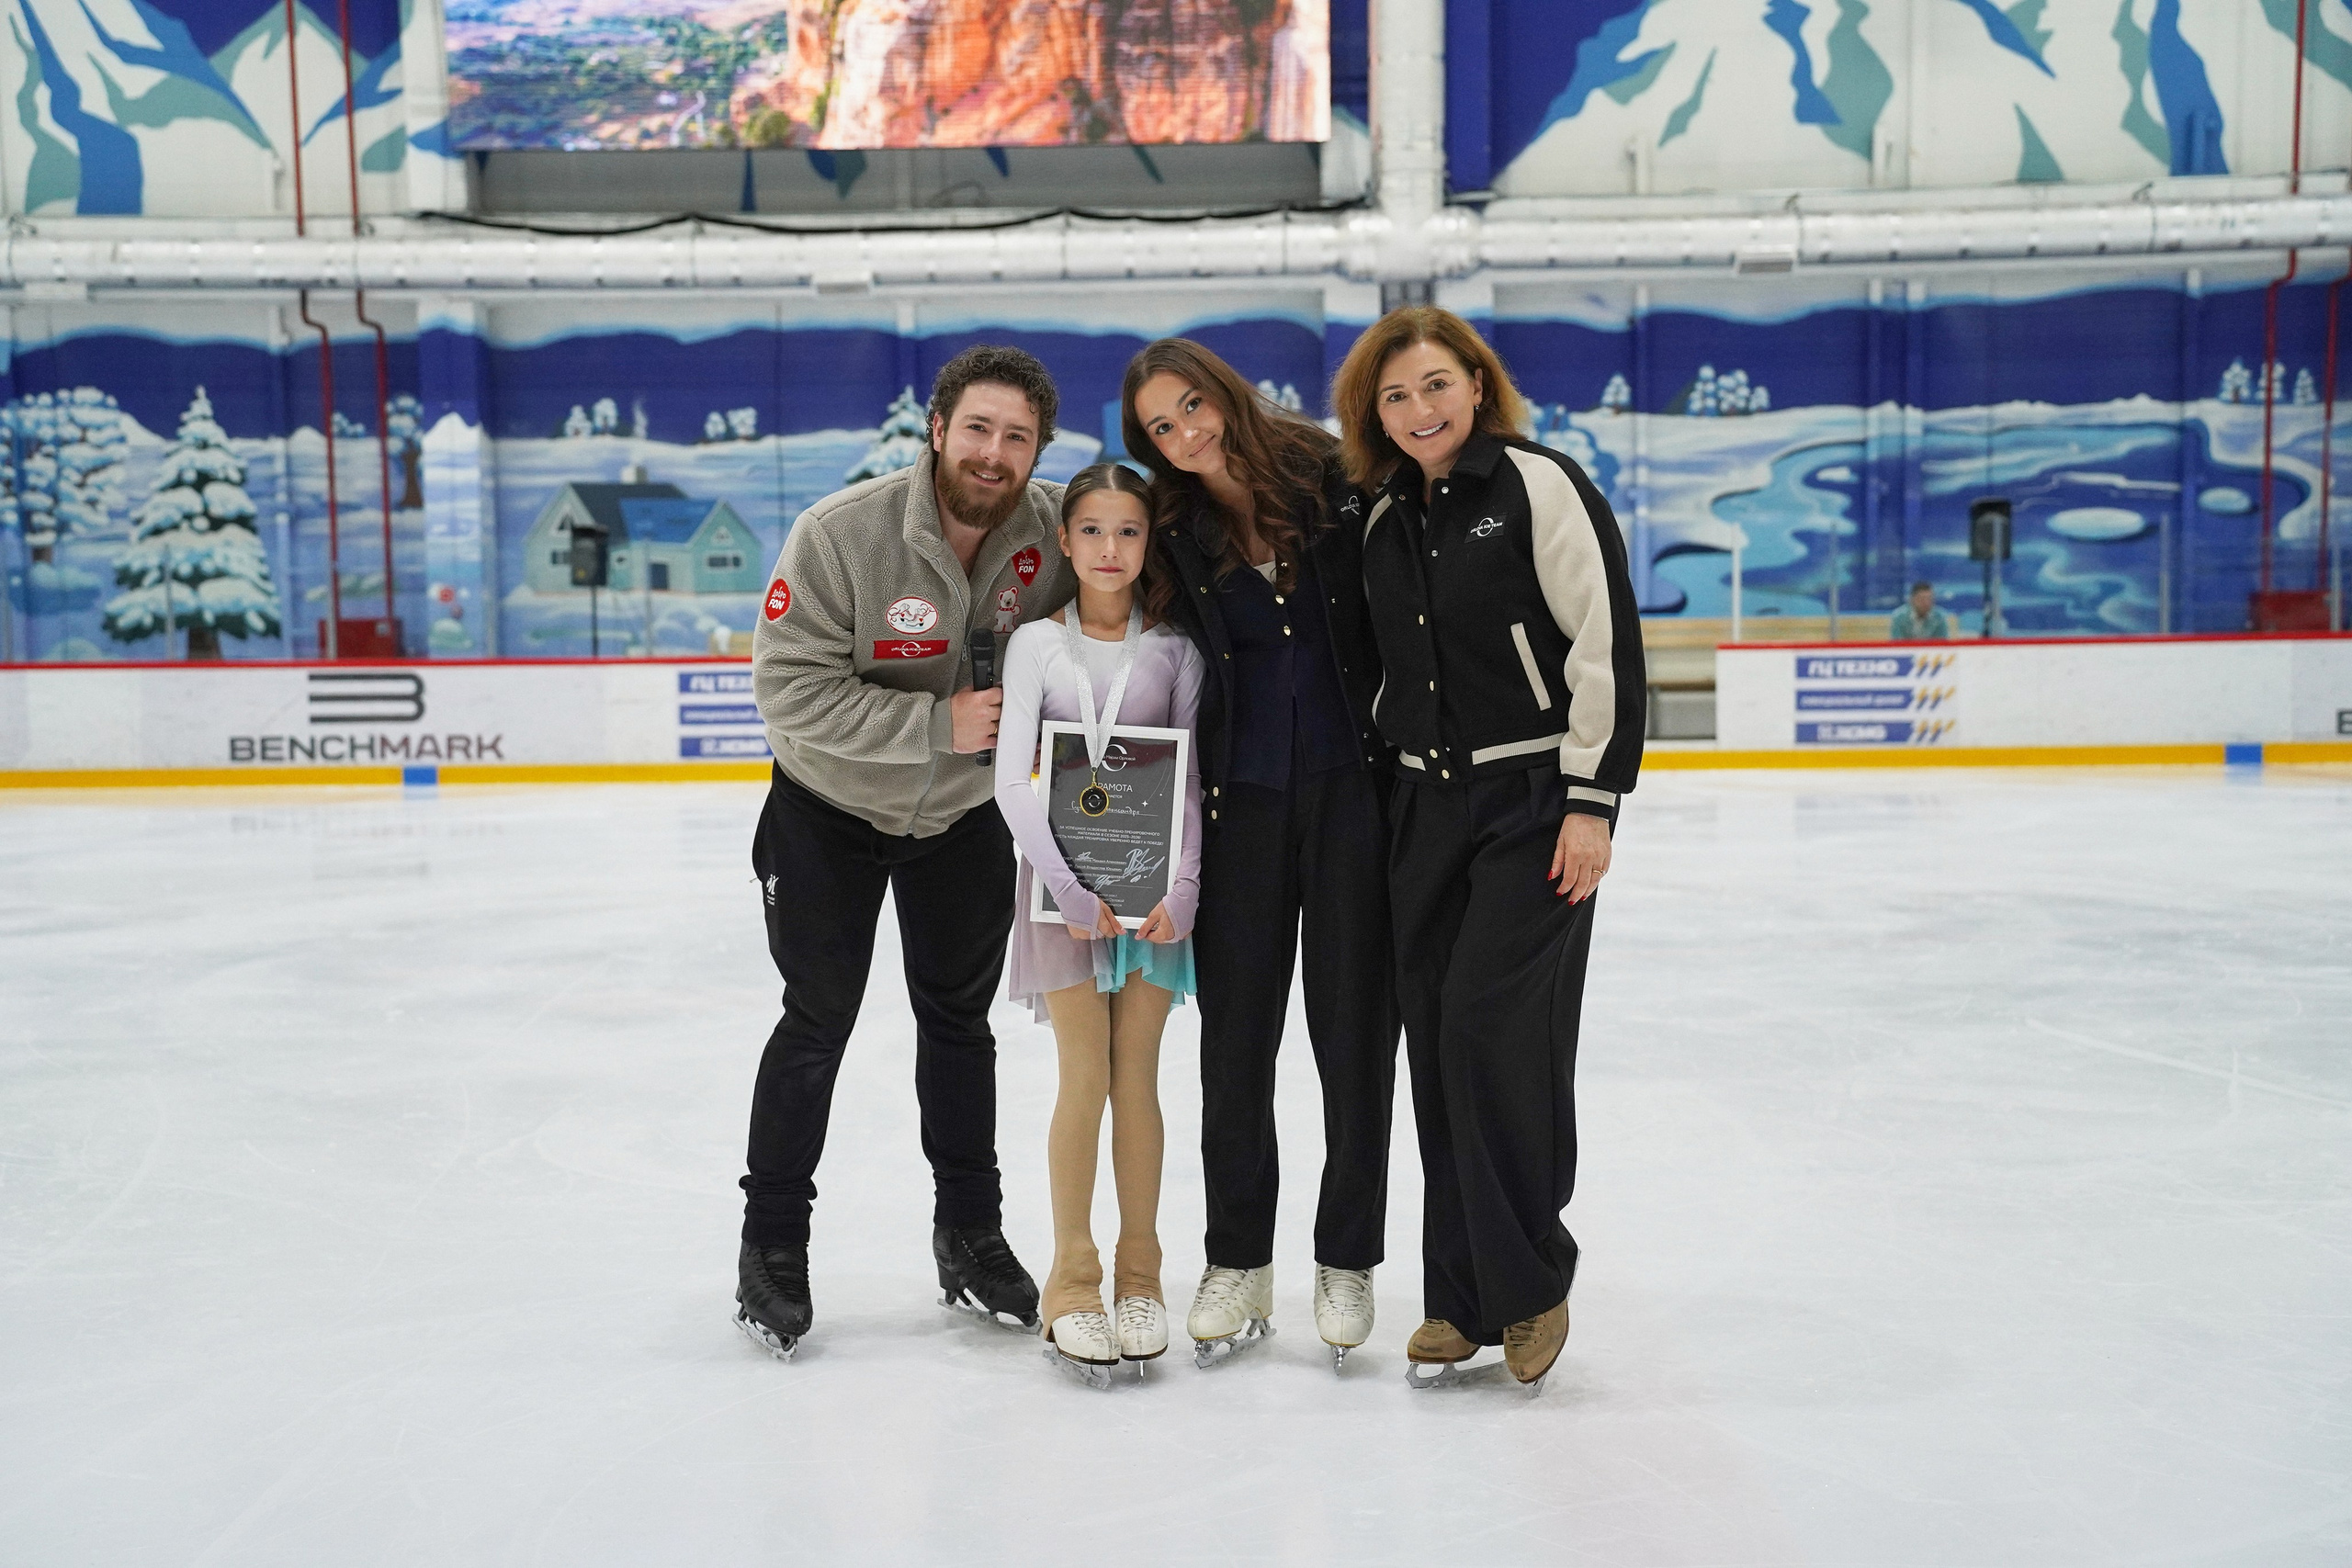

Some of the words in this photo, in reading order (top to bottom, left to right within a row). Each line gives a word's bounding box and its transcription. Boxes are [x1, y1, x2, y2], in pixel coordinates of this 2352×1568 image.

[1018, 565, 1035, 573] FON
[768, 598, 785, 610] FON
[229, 734, 503, 762] BENCHMARK
[1097, 783, 1133, 792] РАМОТА
